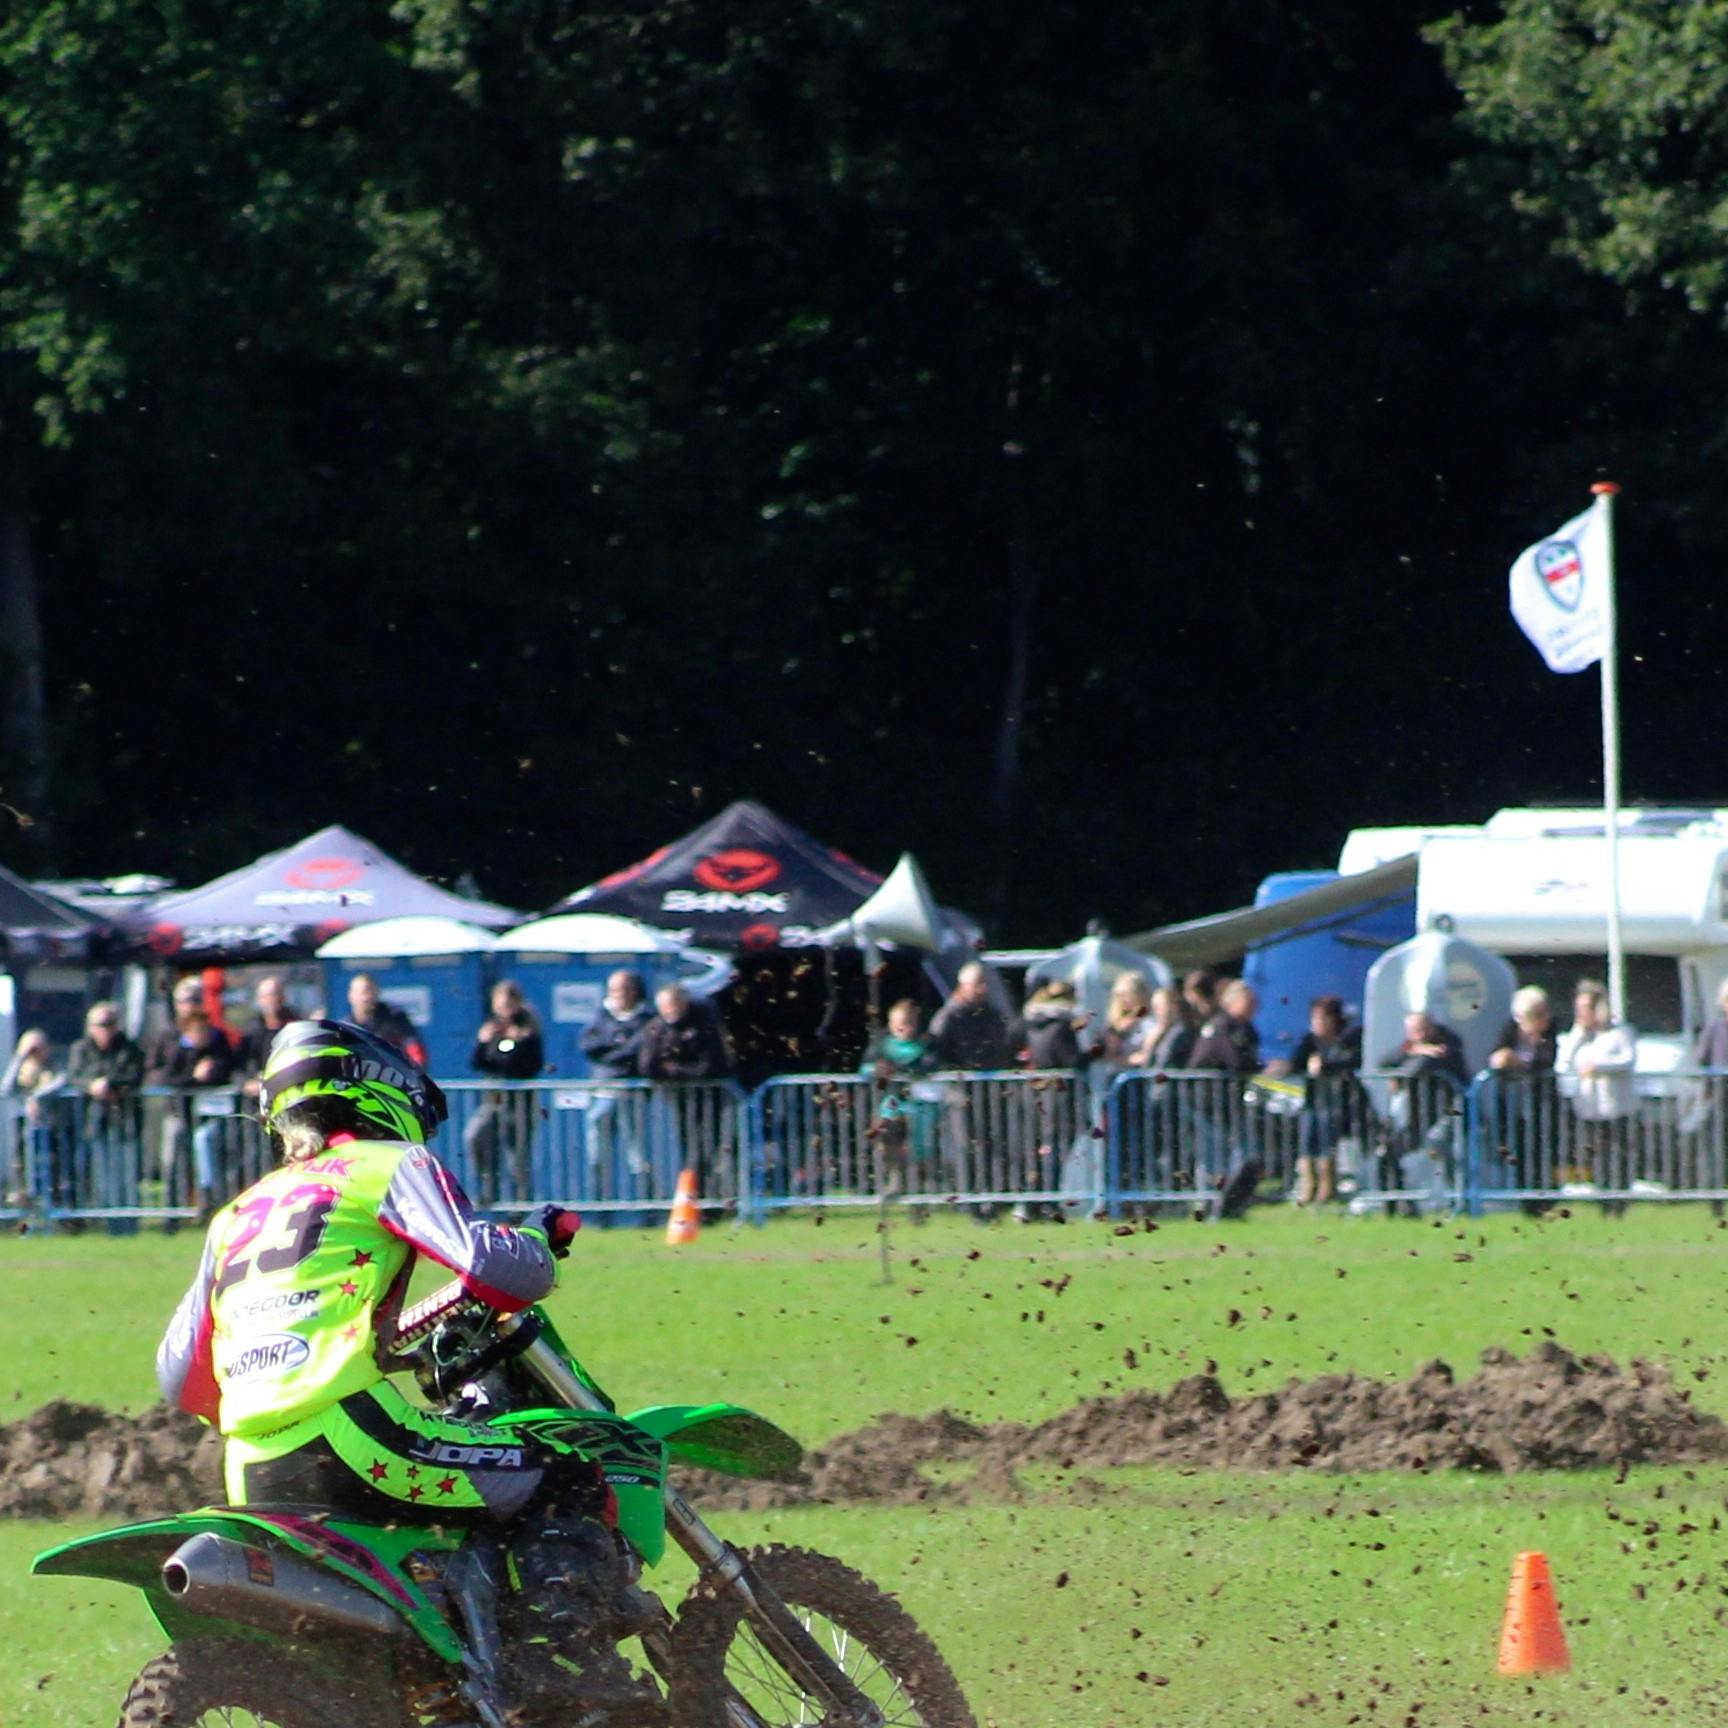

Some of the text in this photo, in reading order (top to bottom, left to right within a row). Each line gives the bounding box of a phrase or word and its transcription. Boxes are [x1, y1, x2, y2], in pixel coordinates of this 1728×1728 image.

[215, 1182, 340, 1302] 23
[408, 1442, 522, 1467] JOPA
[605, 1474, 640, 1484] 250
